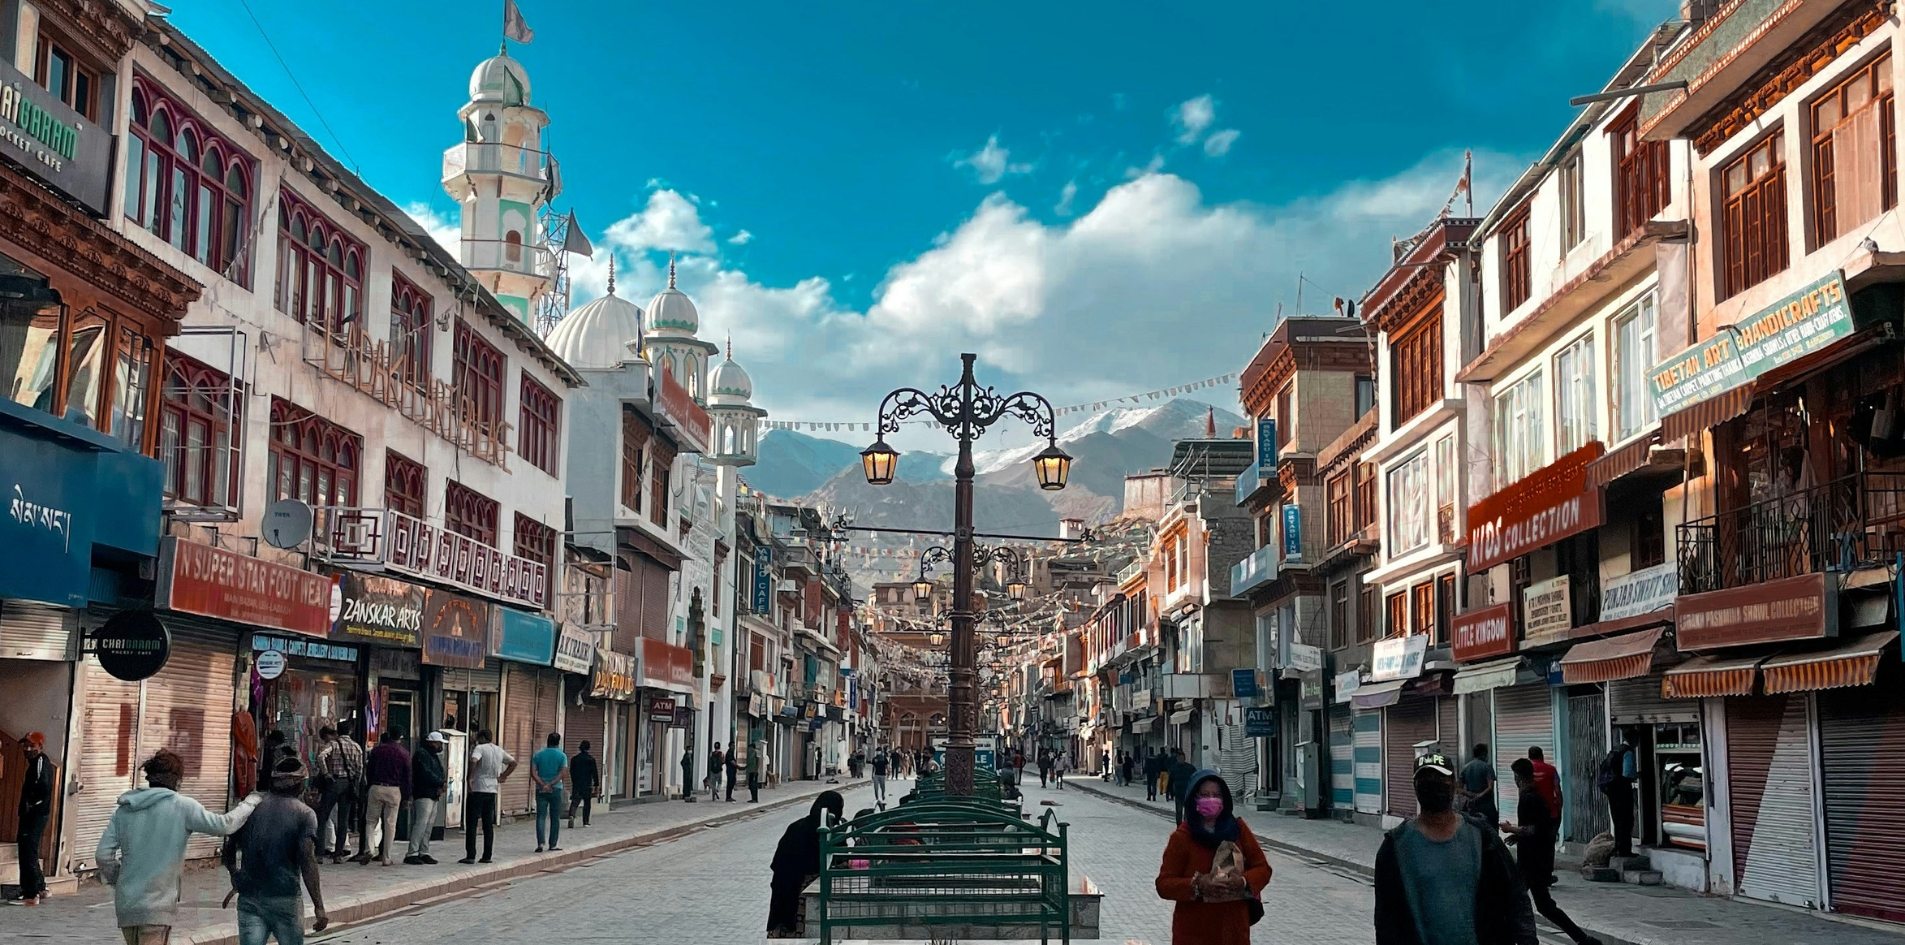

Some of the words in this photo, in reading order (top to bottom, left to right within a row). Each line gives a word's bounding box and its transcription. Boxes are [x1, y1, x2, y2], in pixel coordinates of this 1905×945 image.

[36, 150, 61, 172] CAFE
[1652, 354, 1701, 393] TIBETAN
[1703, 339, 1730, 369] ART
[1741, 279, 1843, 347] HANDICRAFTS
[325, 307, 418, 421] LADAKH
[459, 394, 514, 475] PALACE
[1471, 516, 1502, 567] KIDS
[1504, 497, 1580, 550] COLLECTION
[194, 551, 235, 587] SUPER
[238, 562, 266, 595] STAR
[269, 568, 299, 602] FOOT
[300, 577, 329, 609] WEAR
[758, 582, 767, 613] CAFE
[1602, 583, 1634, 612] PUNJAB
[1705, 606, 1741, 628] PASHMINA
[1742, 603, 1770, 623] SHAWL
[1770, 595, 1820, 619] COLLECTION
[343, 598, 395, 629] ZANSKAR
[396, 607, 422, 631] ARTS
[102, 638, 160, 650] CHAIGARAM
[1455, 624, 1474, 650] LITTLE
[1475, 616, 1507, 646] KINGDOM
[653, 702, 672, 710] ATM
[1247, 710, 1273, 721] ATM
